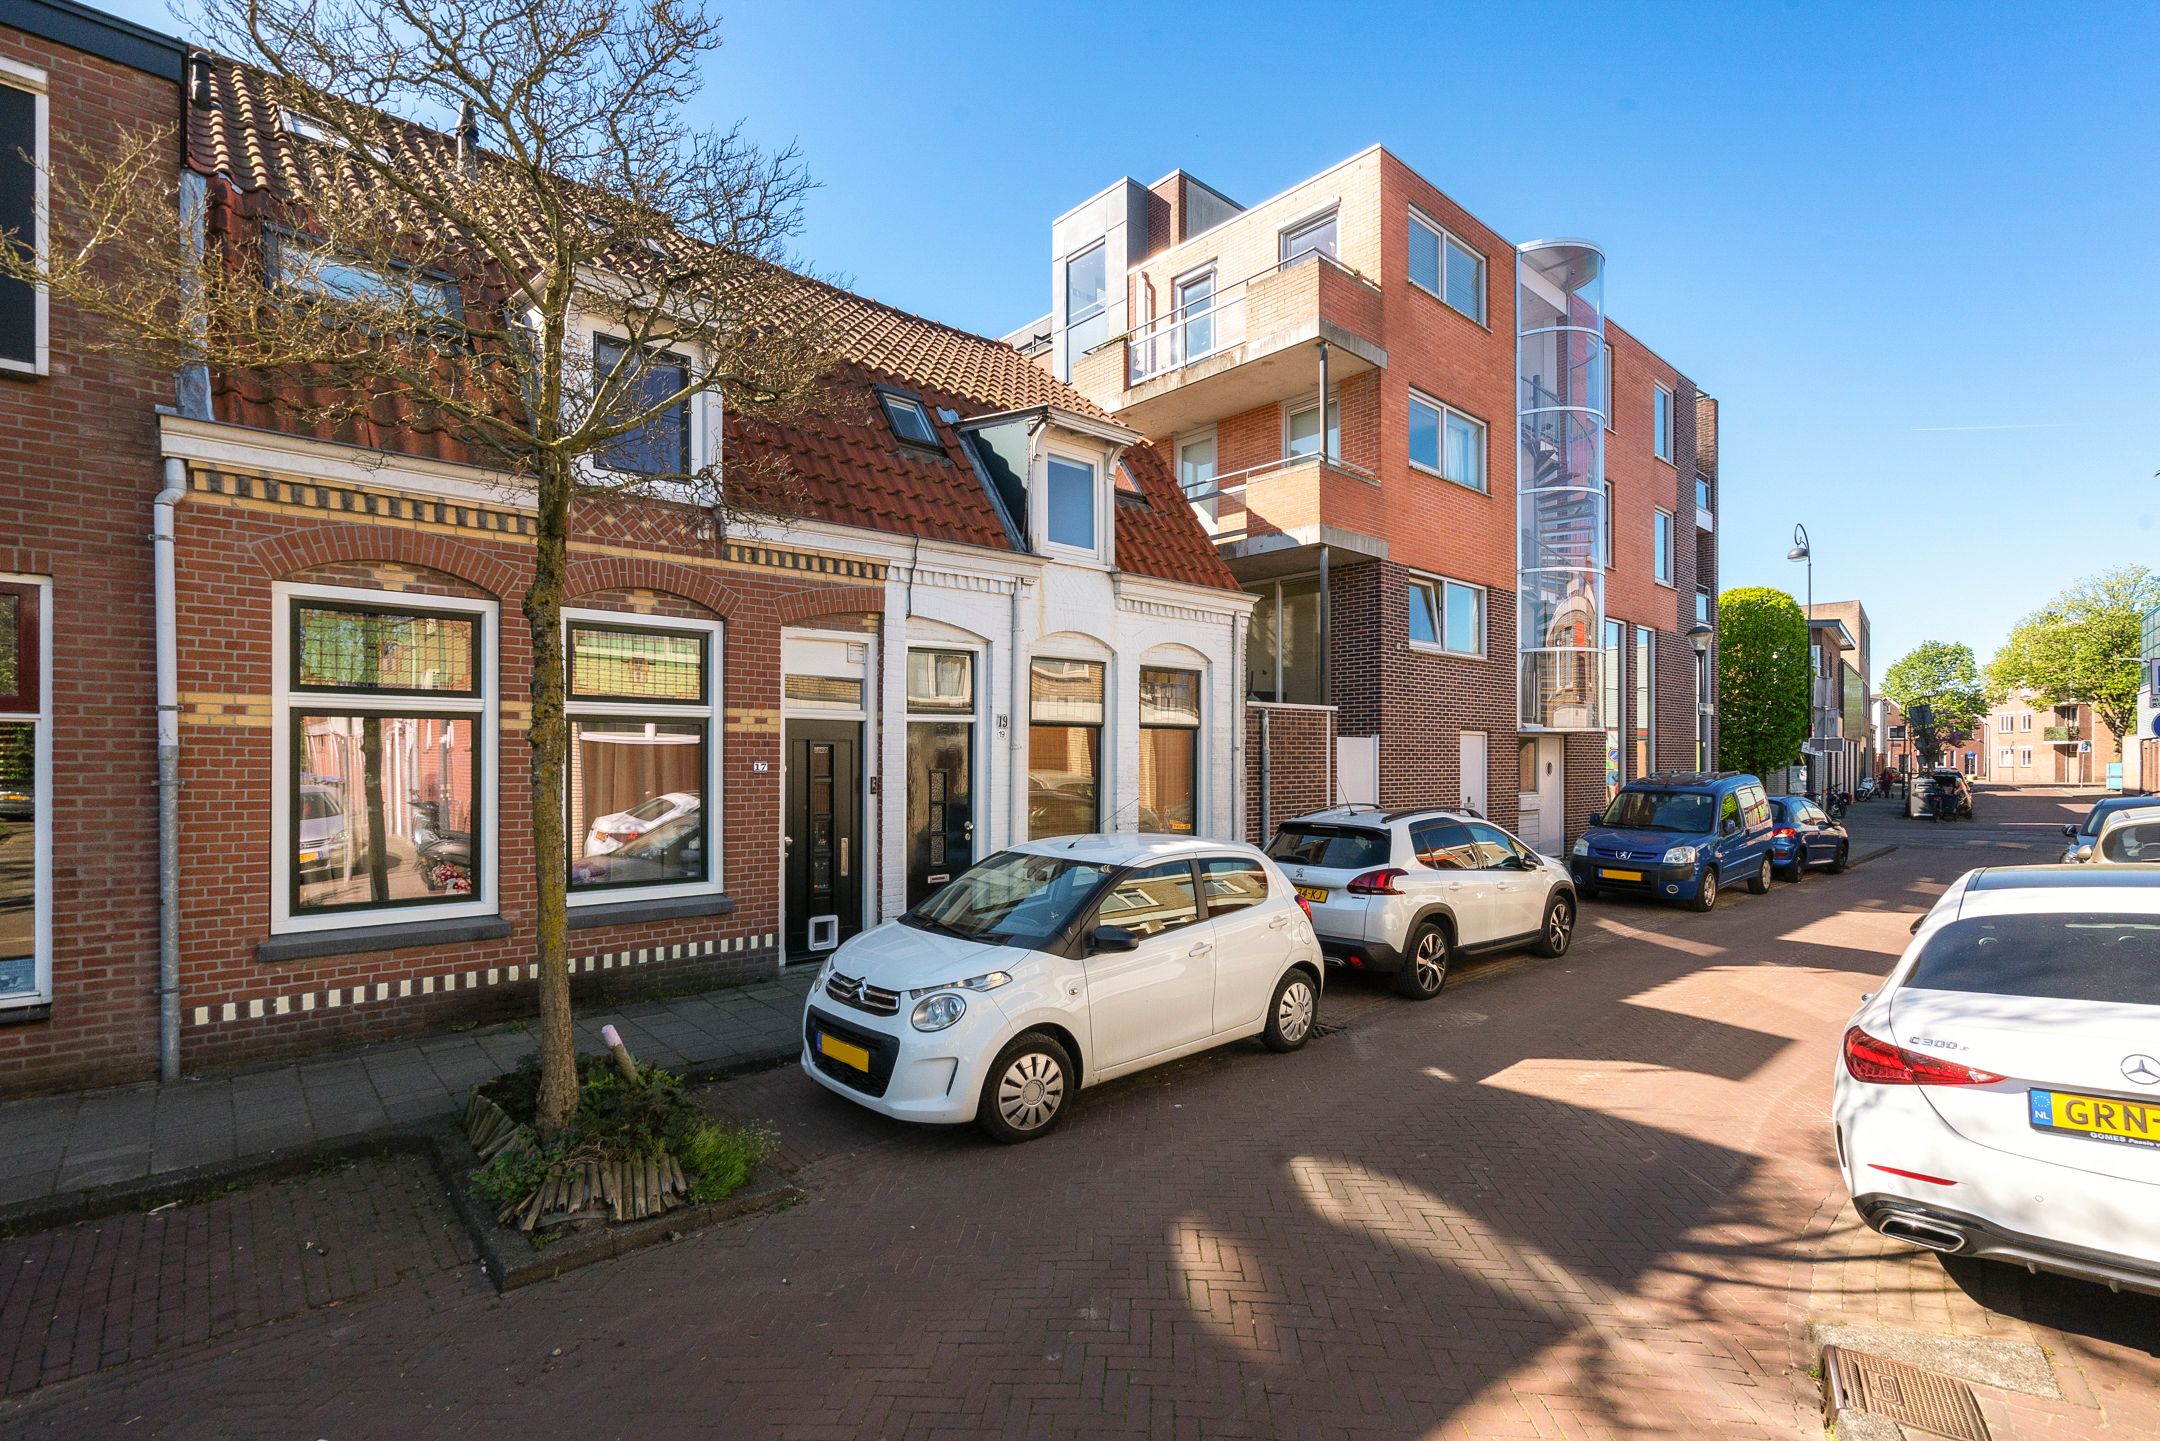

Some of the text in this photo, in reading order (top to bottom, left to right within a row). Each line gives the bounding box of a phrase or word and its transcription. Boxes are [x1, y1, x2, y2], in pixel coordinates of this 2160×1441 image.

[998, 715, 1008, 728] 19
[998, 730, 1006, 738] 19
[754, 763, 767, 771] 17
[1296, 887, 1323, 900] 34-KJ
[1909, 1036, 1920, 1045] C
[1922, 1038, 1958, 1049] 300
[2034, 1110, 2050, 1120] NL
[2089, 1132, 2126, 1143] GOMES
